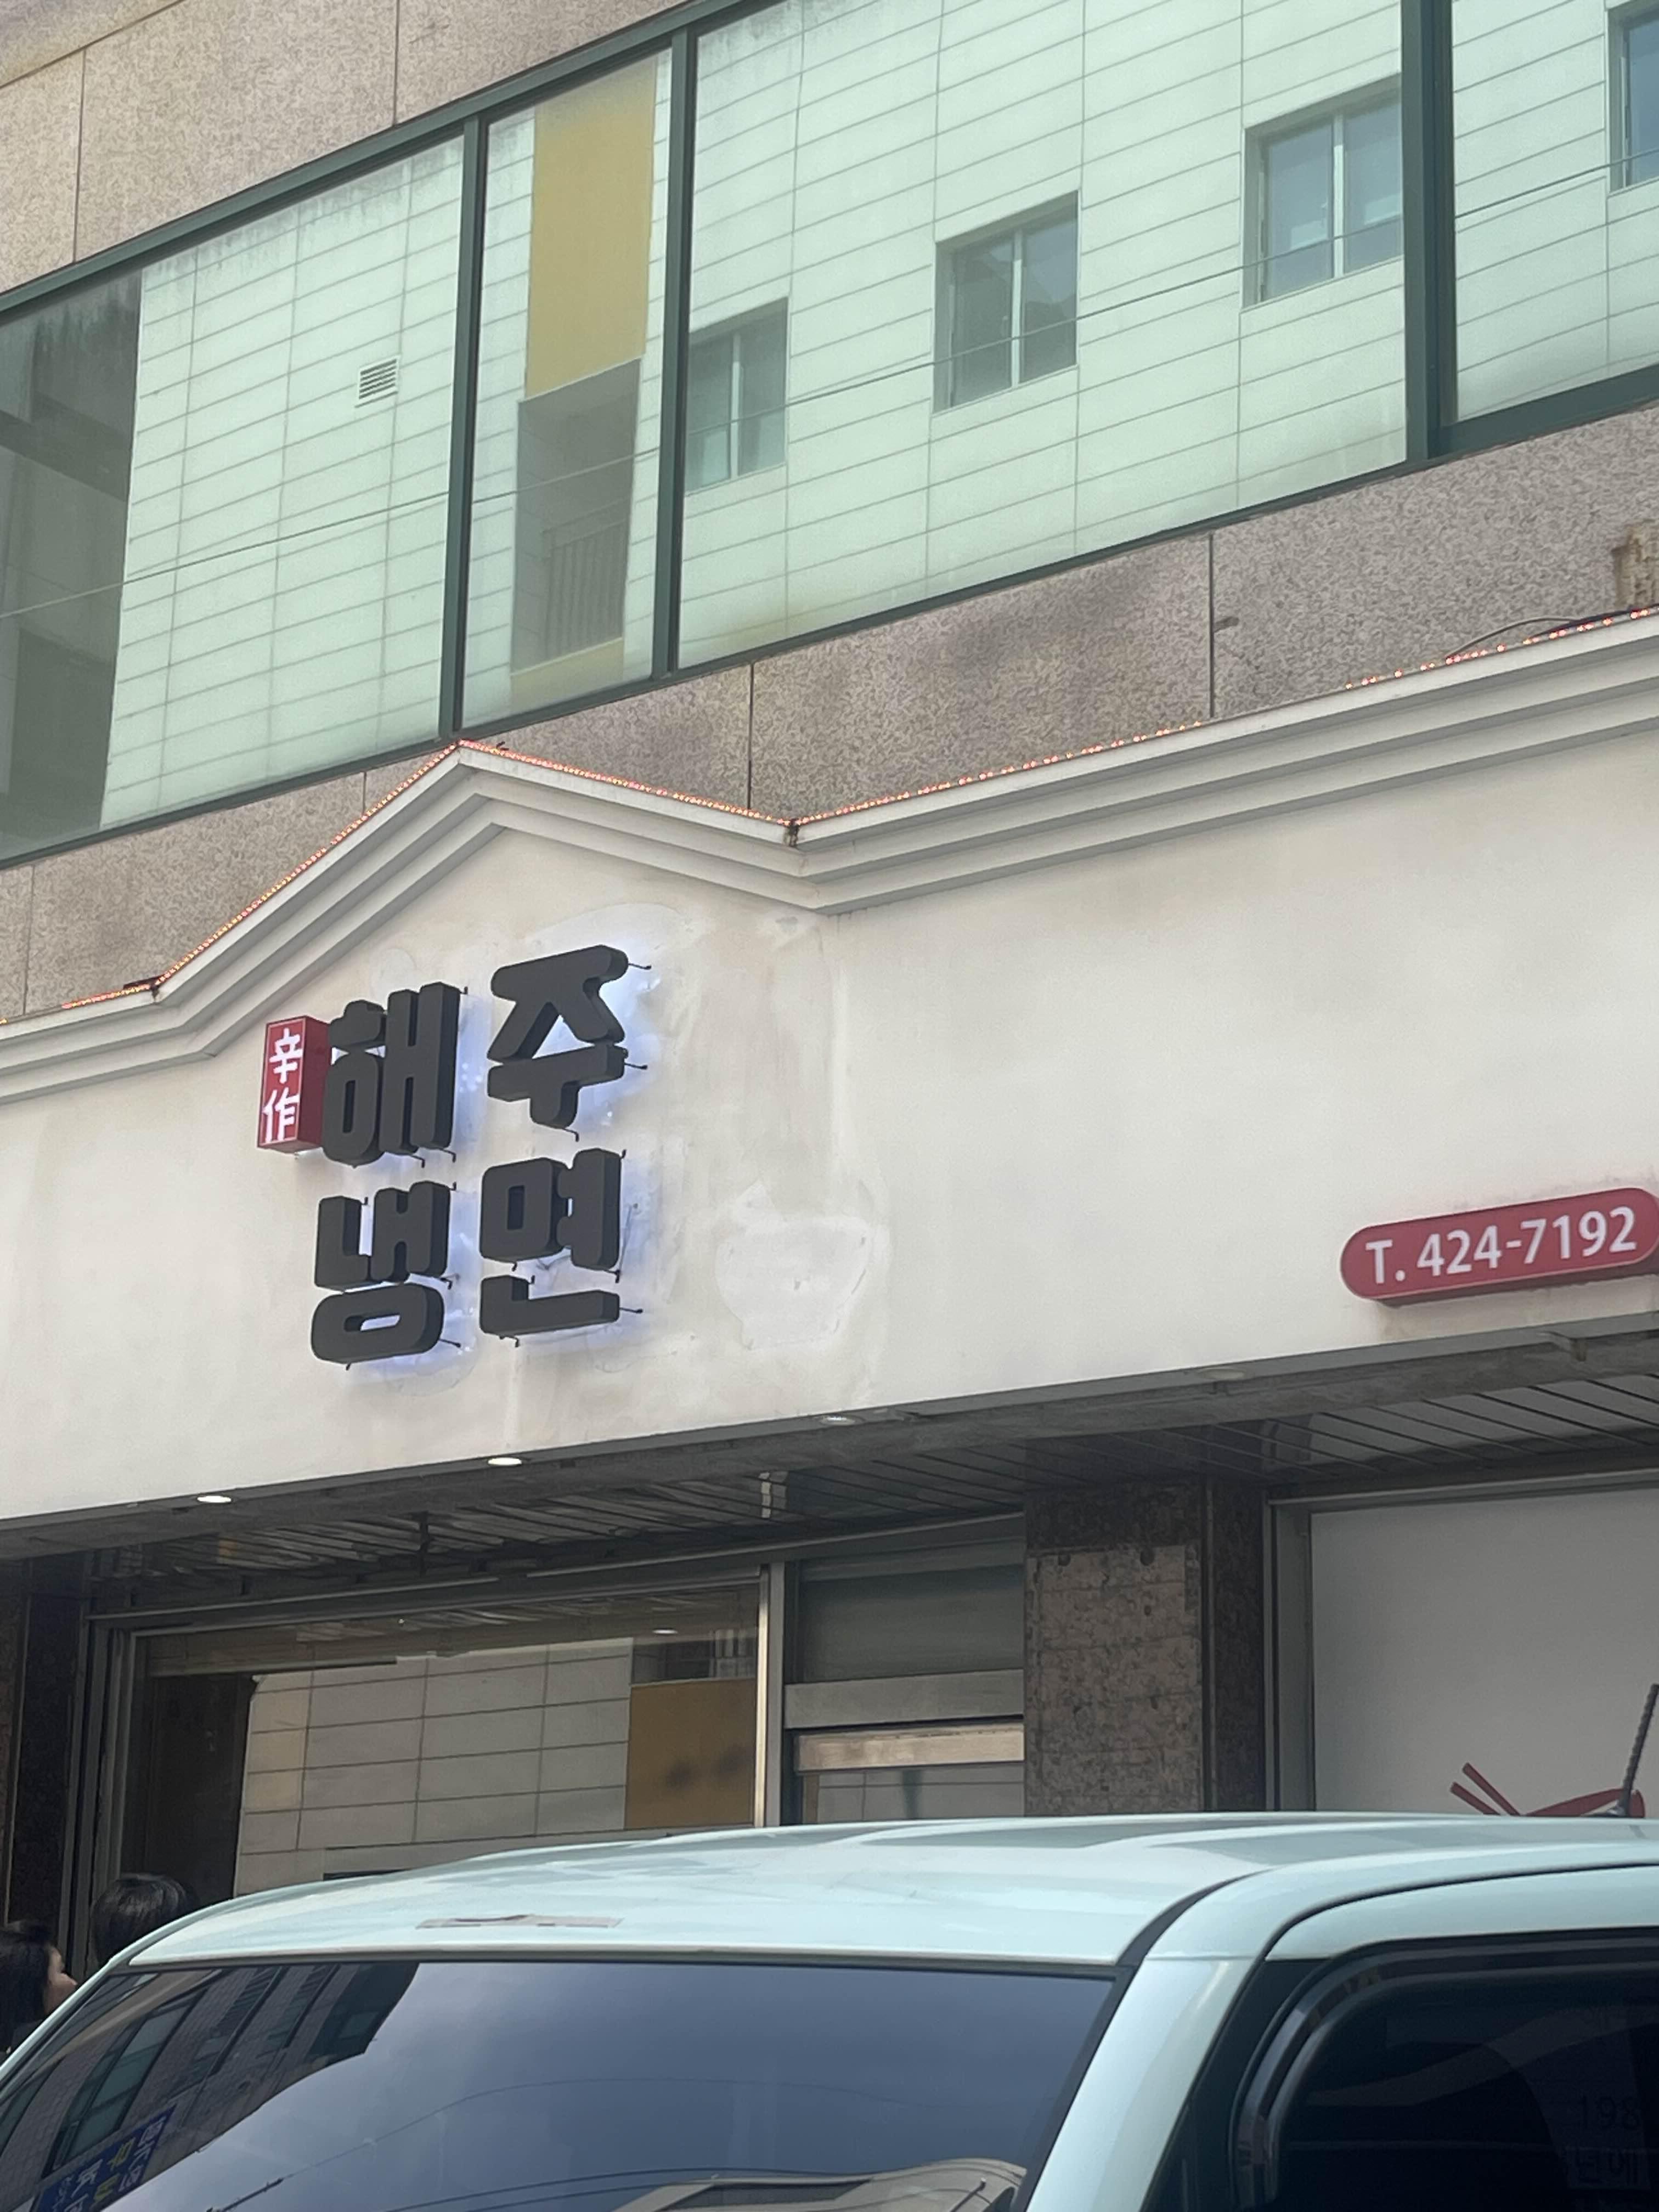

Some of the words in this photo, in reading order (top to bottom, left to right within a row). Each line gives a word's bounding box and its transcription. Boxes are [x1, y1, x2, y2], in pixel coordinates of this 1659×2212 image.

[323, 945, 629, 1166] 해주
[311, 1148, 623, 1364] 냉면
[1365, 1239, 1406, 1284] T.
[1417, 1206, 1638, 1277] 424-7192
